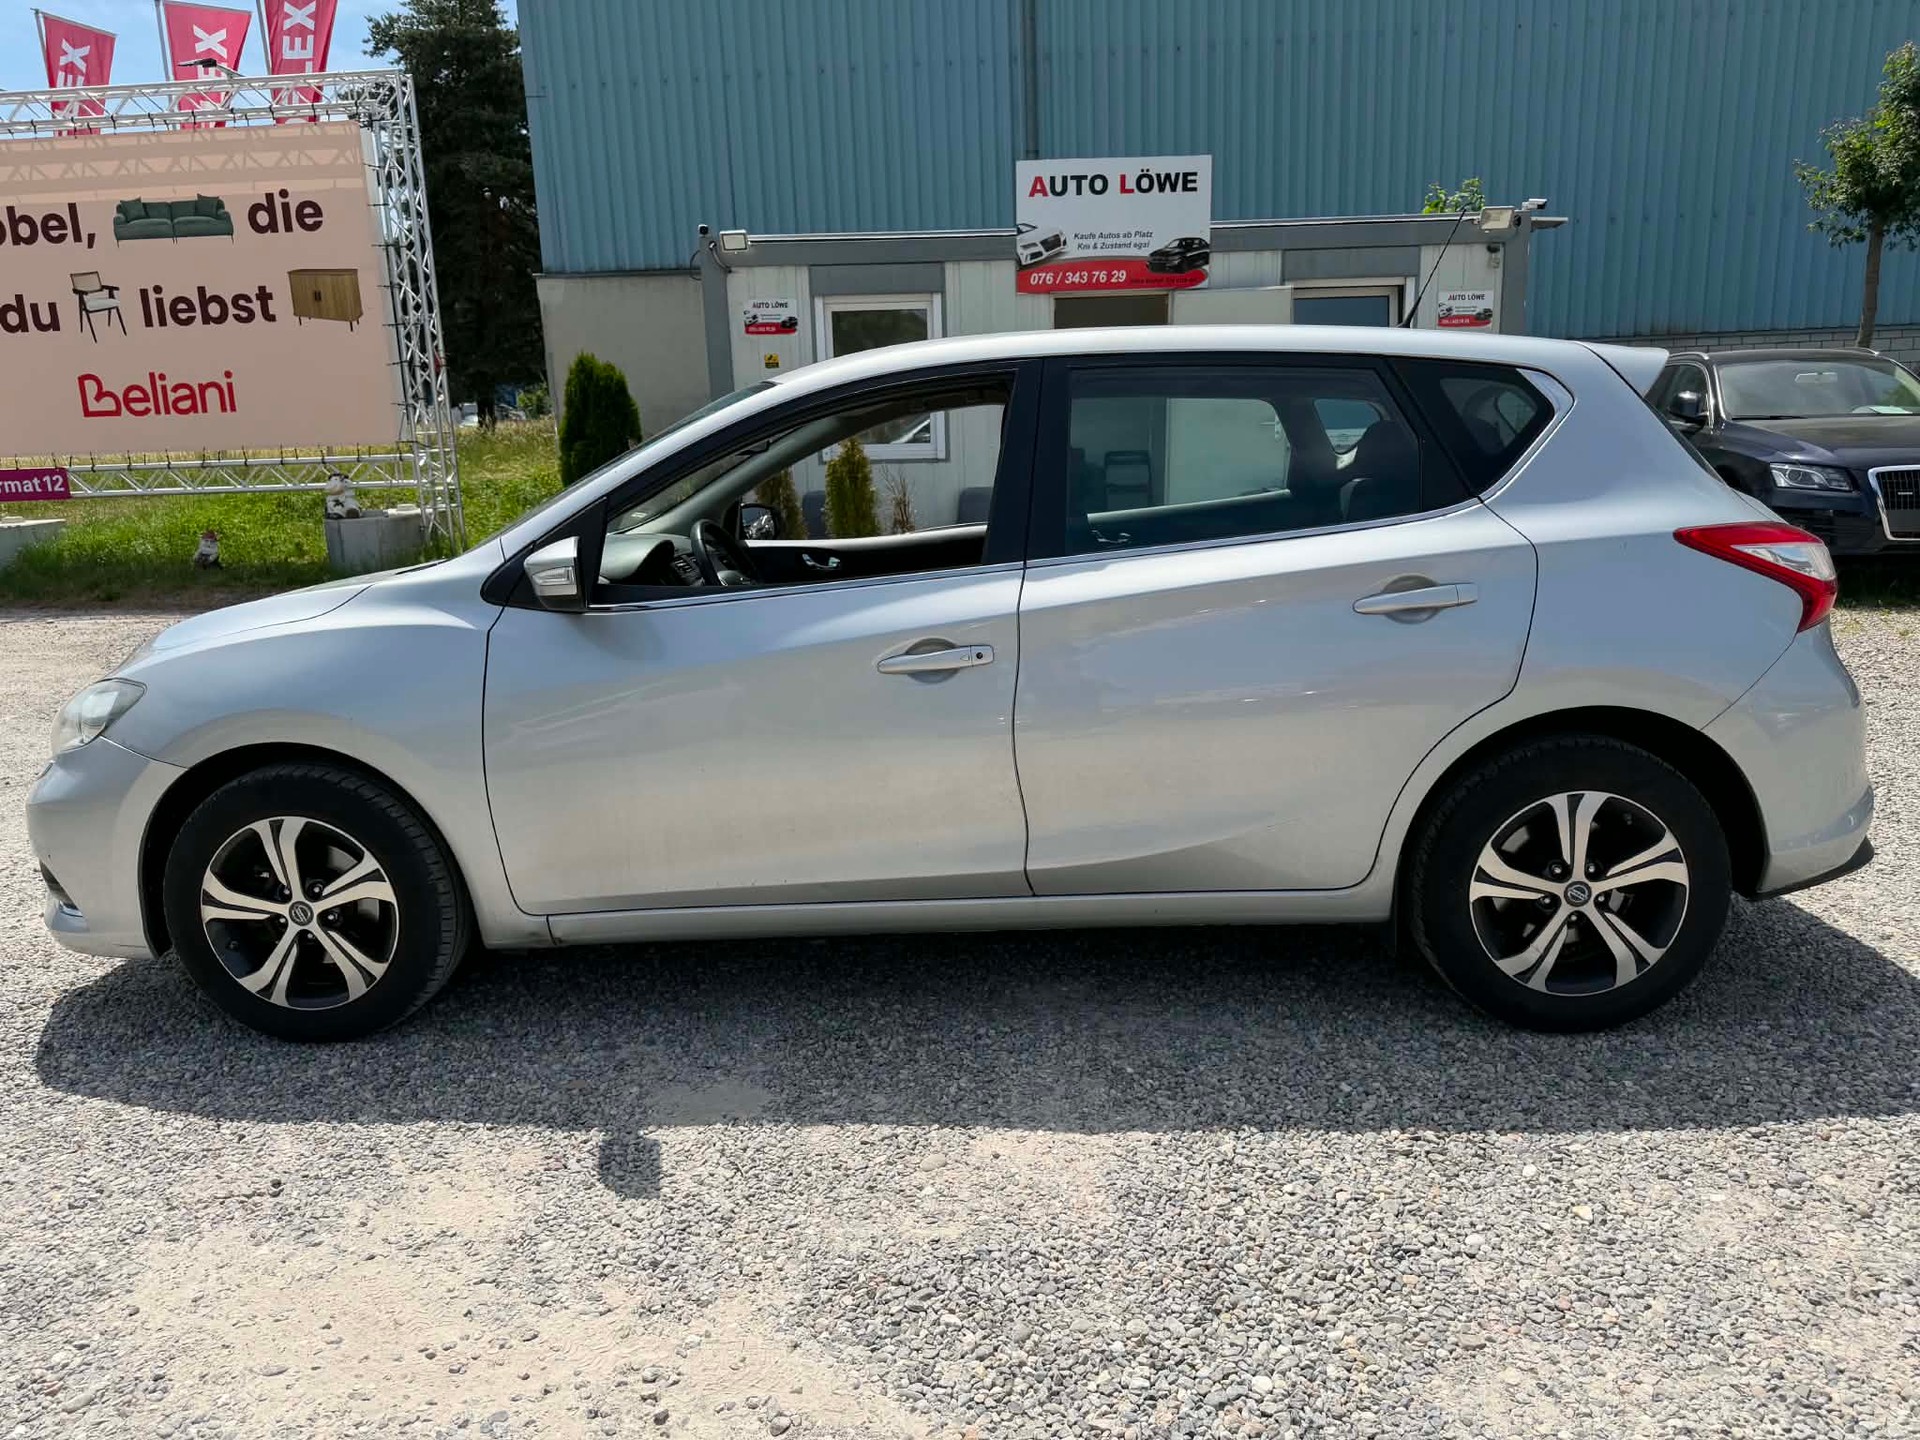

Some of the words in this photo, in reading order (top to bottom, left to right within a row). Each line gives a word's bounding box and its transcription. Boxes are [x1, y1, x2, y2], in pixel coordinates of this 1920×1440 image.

[1028, 174, 1109, 198] AUTO
[1119, 168, 1198, 195] LÖWE
[0, 202, 96, 249] bel,
[247, 187, 324, 236] die
[1073, 232, 1096, 240] Kaufe
[1098, 231, 1120, 239] Autos
[1122, 231, 1132, 239] ab
[1134, 230, 1153, 238] Platz
[1092, 242, 1099, 250] &
[1100, 241, 1132, 249] Zustand
[1133, 240, 1150, 250] egal
[1030, 272, 1054, 285] 076
[1055, 271, 1063, 284] /
[1064, 271, 1089, 284] 343
[1092, 270, 1107, 283] 76
[1110, 269, 1127, 283] 29
[0, 294, 61, 333] du
[139, 284, 277, 328] liebst
[77, 369, 237, 418] Beliani
